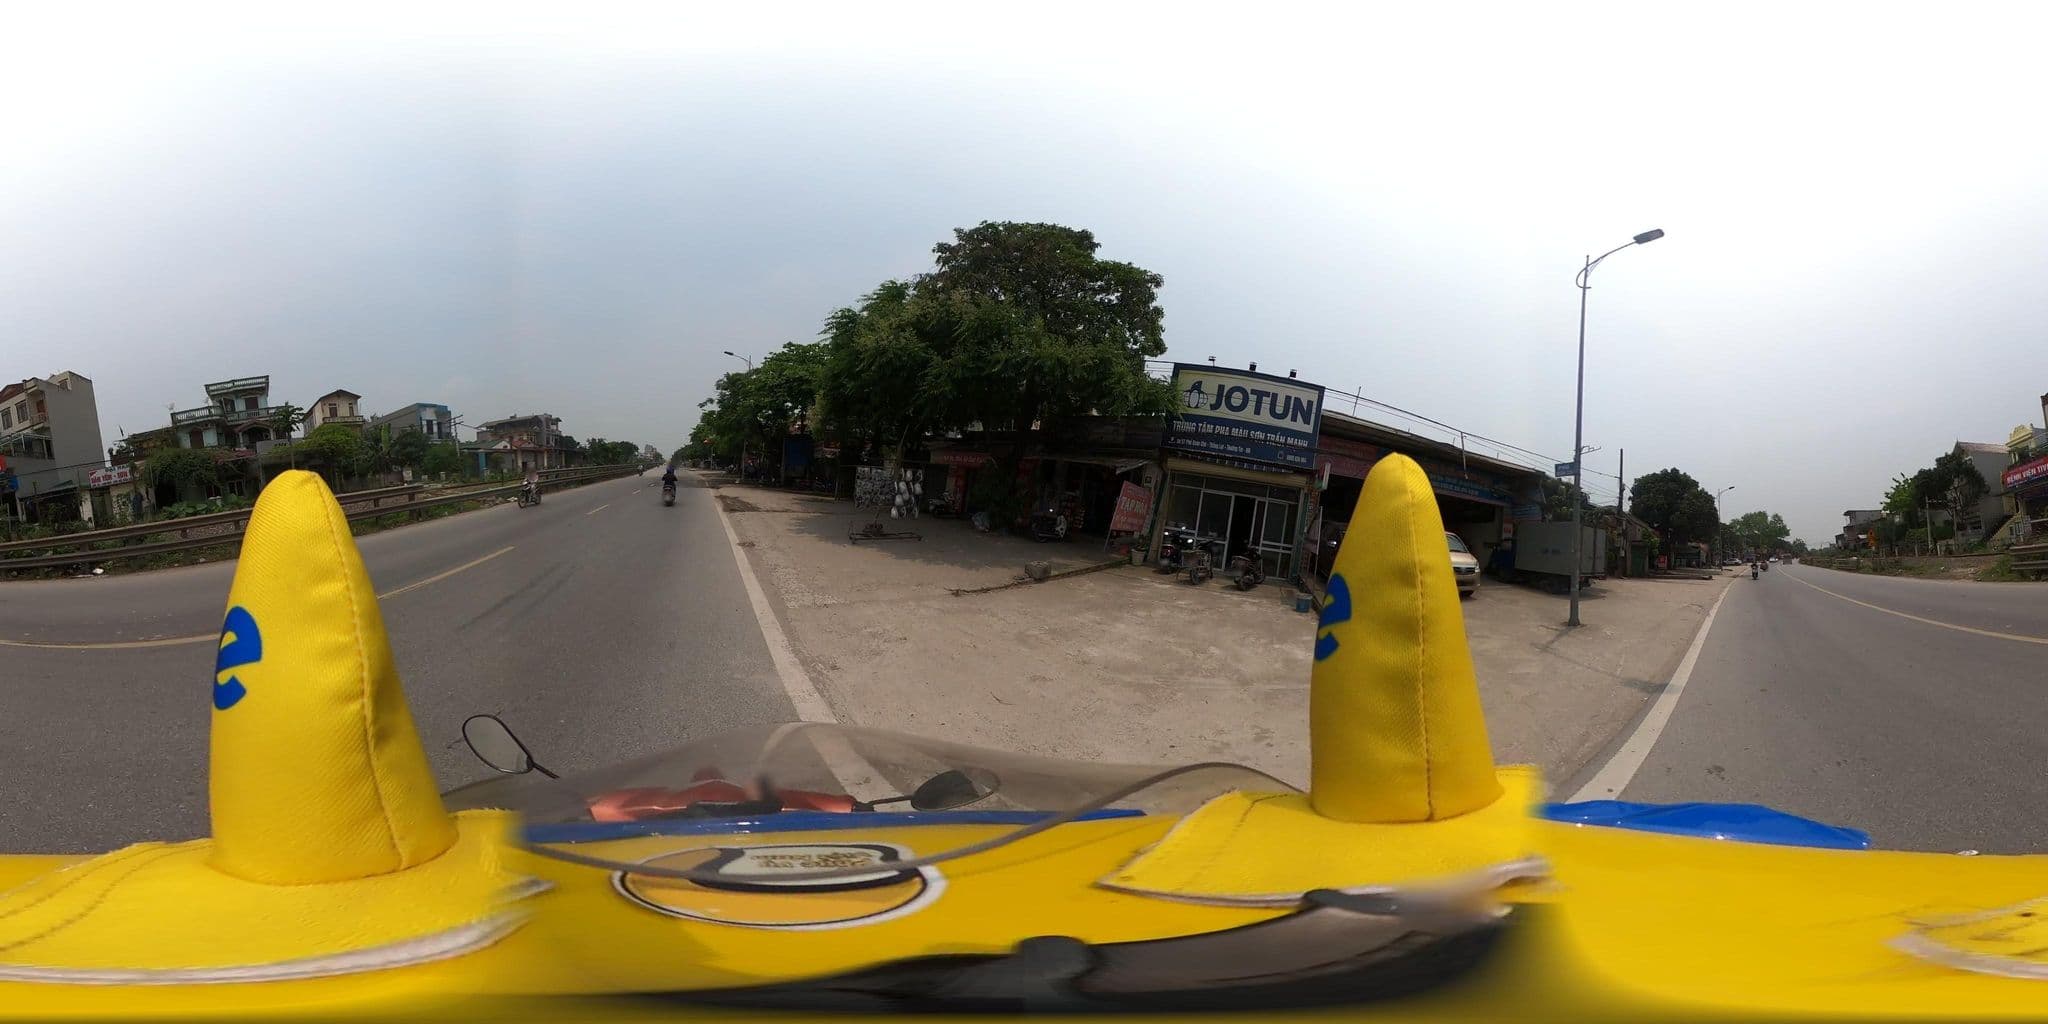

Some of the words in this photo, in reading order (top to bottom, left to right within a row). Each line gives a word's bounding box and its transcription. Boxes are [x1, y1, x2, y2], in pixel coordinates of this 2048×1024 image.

[1210, 384, 1314, 426] JOTUN
[1173, 420, 1196, 433] TRUNG
[1197, 421, 1214, 433] TÂM
